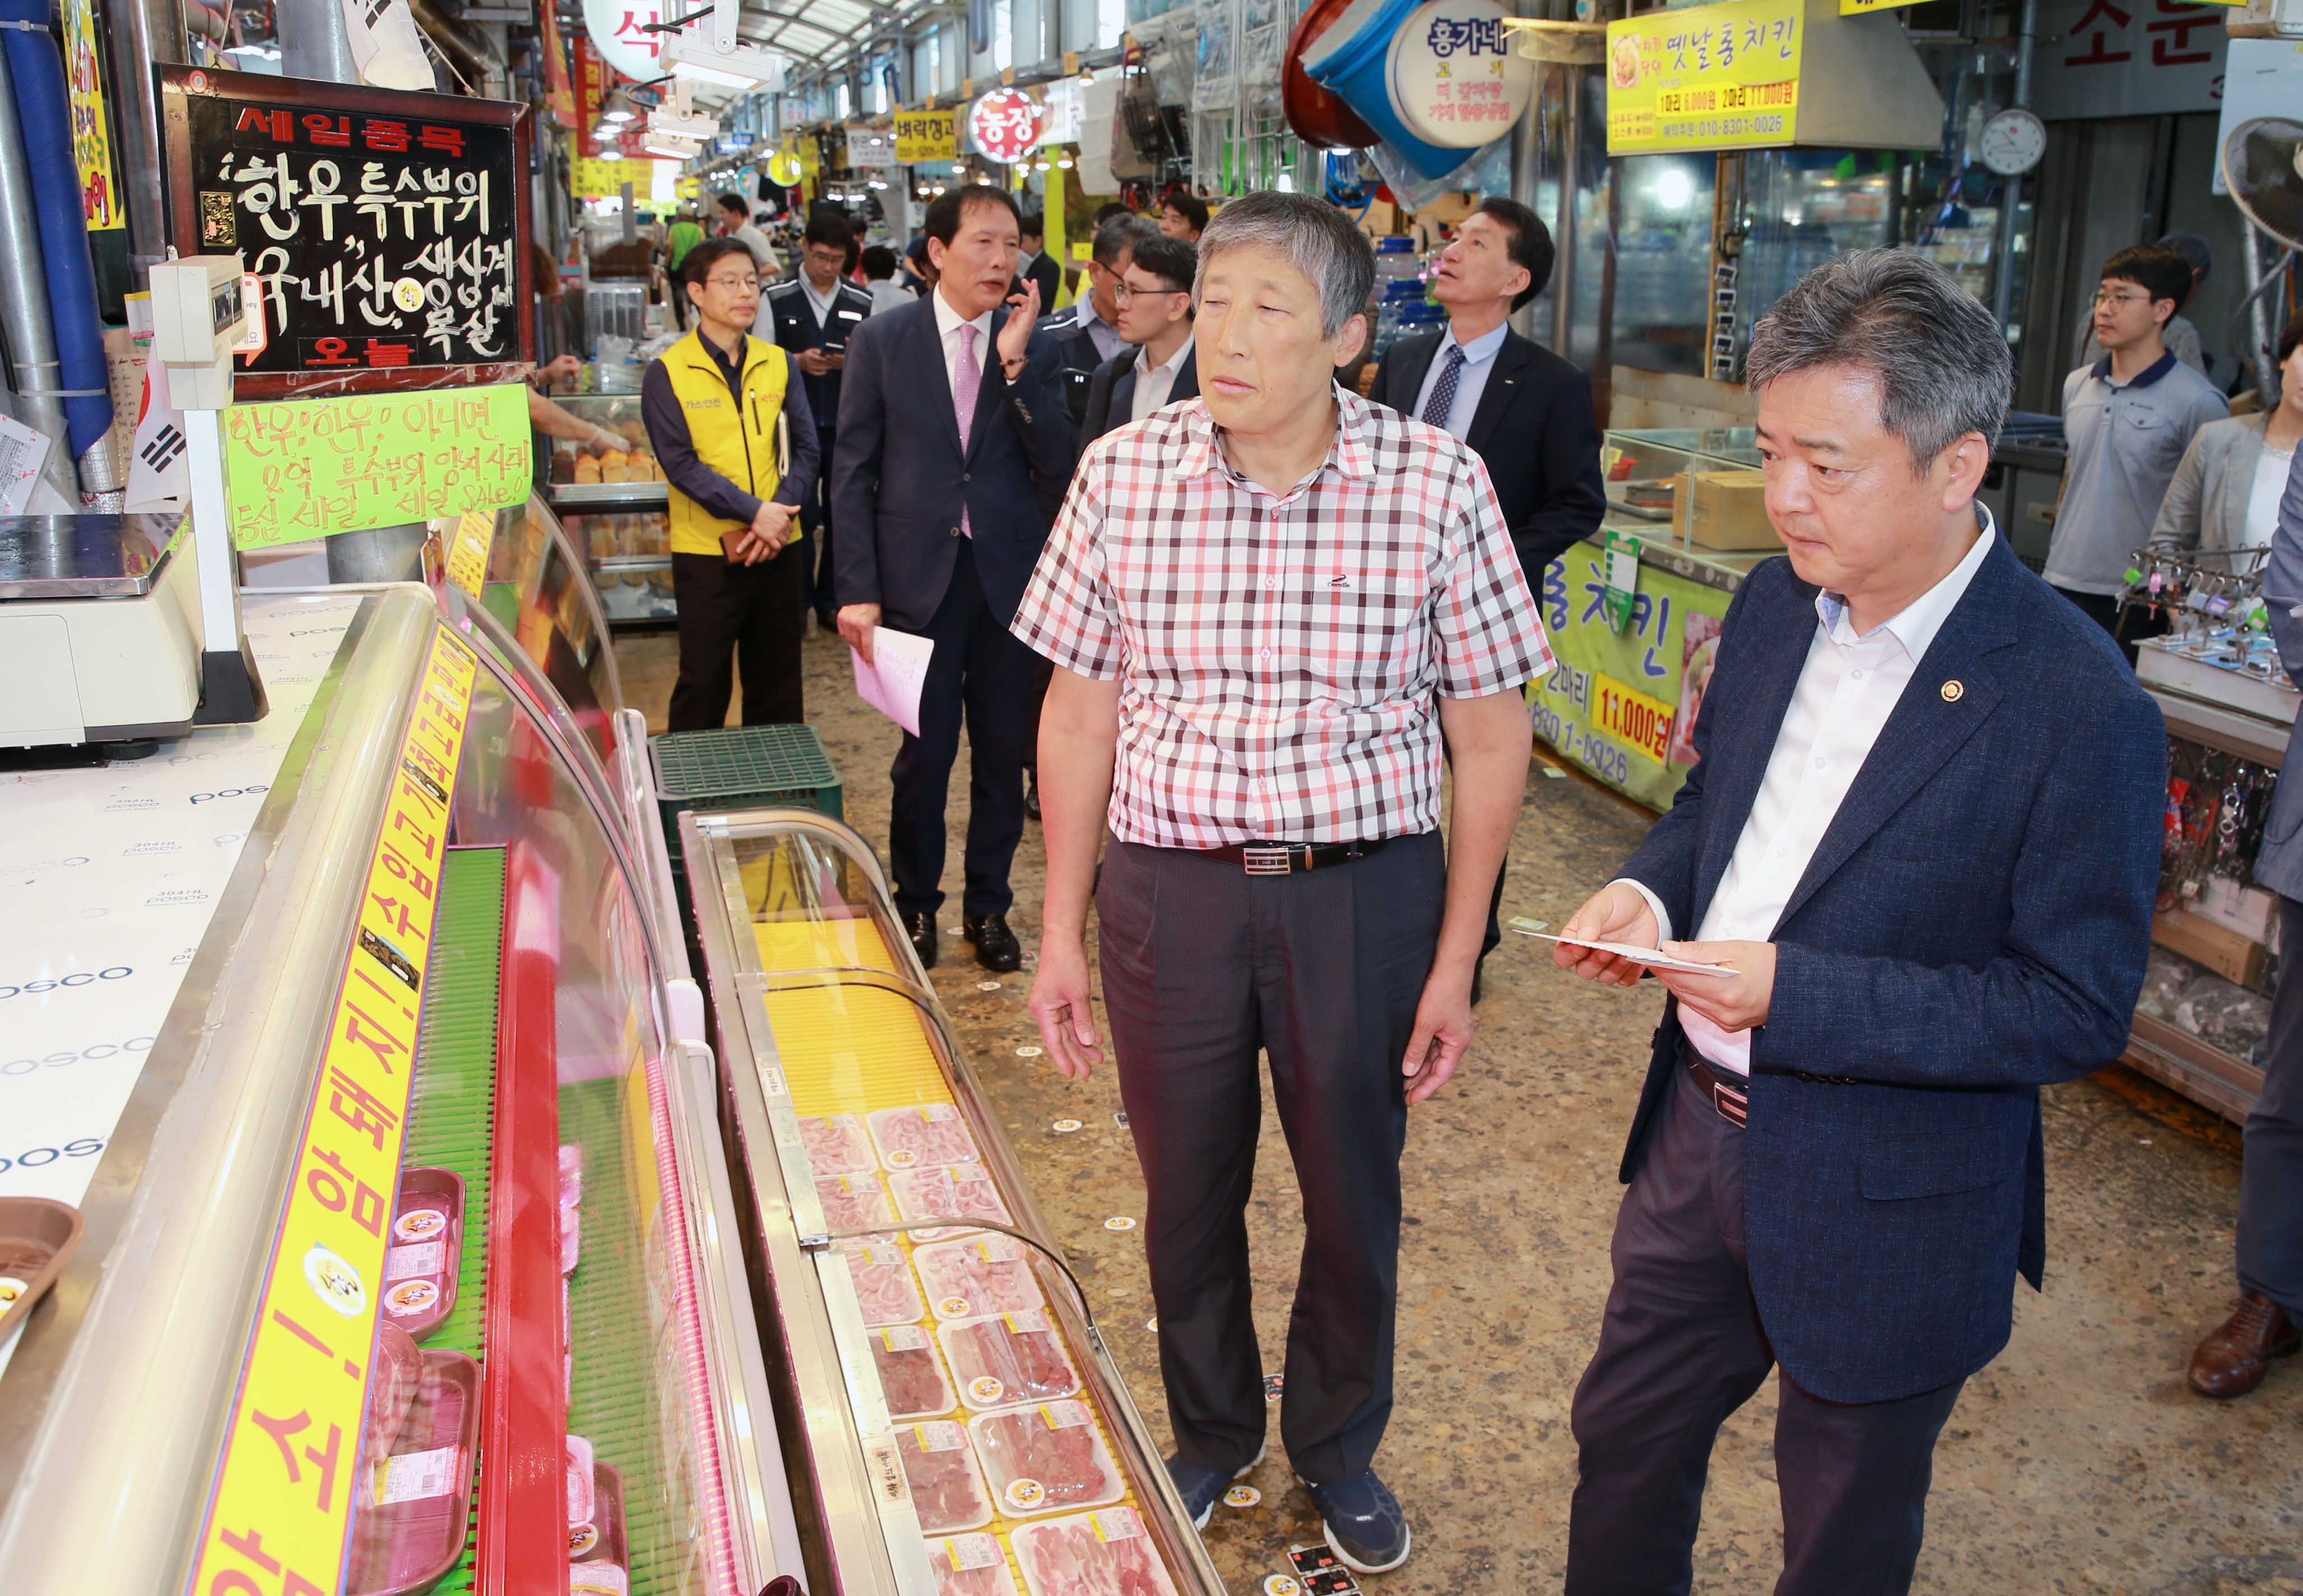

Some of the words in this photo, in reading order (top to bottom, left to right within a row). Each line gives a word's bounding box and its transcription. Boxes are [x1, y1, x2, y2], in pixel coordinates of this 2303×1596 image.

[236, 108, 466, 157] 세일품목
[979, 106, 1034, 143] 농장
[353, 161, 489, 242] 특수부위
[305, 338, 415, 367] 오늘
[402, 397, 499, 442] 아니면
[395, 483, 449, 517] 세일
